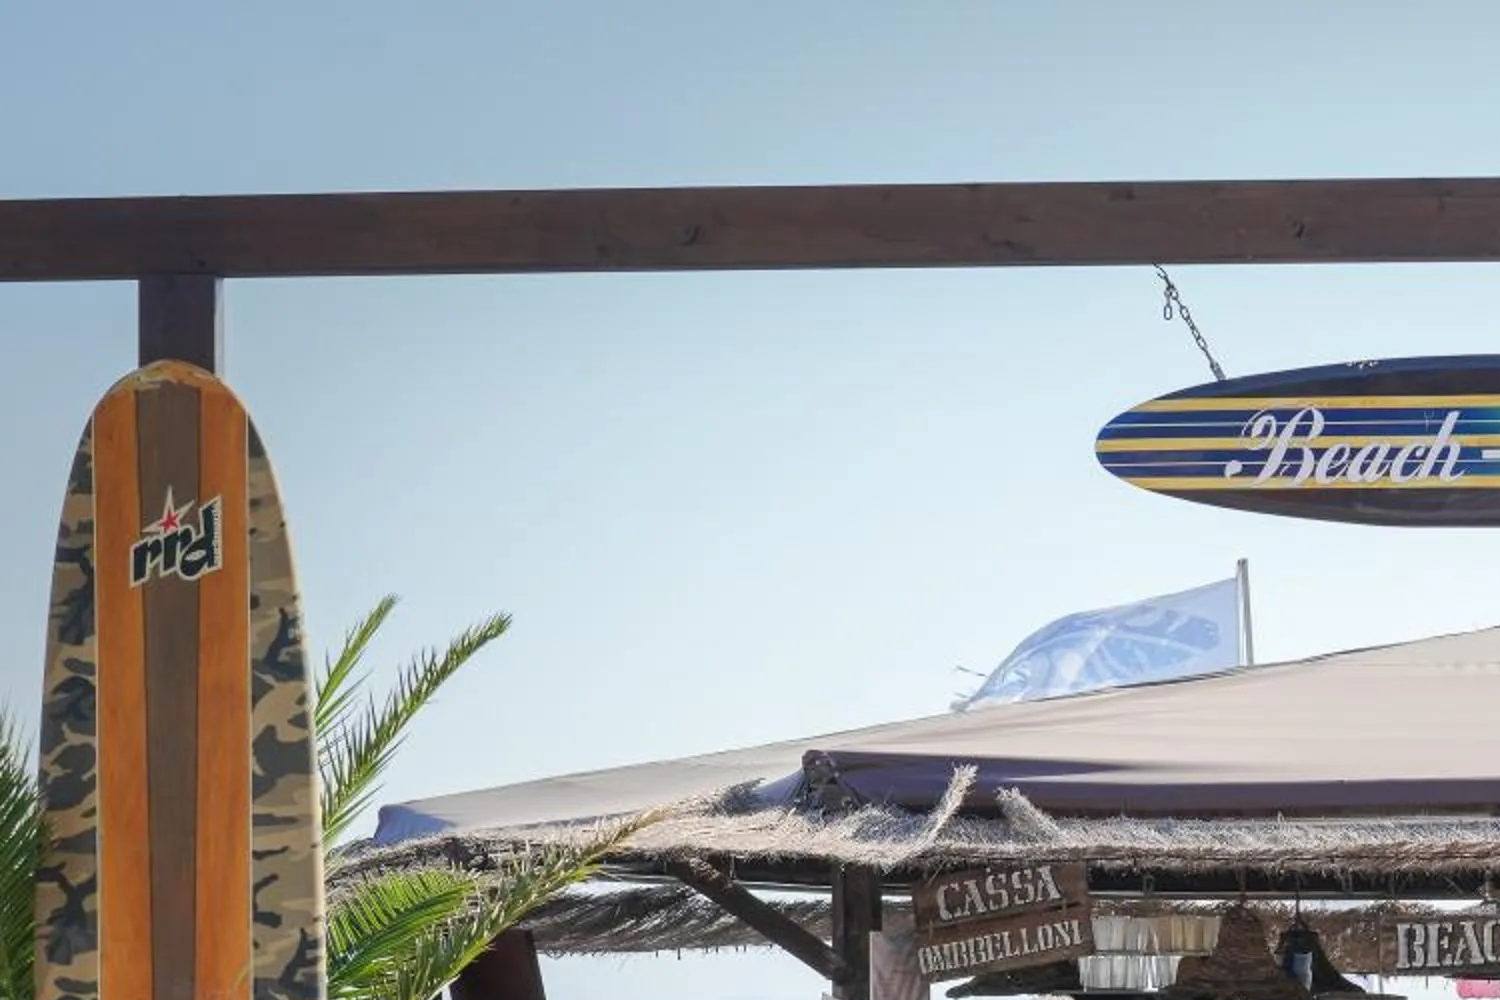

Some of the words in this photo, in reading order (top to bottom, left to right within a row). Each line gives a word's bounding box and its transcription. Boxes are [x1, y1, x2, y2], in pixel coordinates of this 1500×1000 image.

[1224, 402, 1465, 488] Beach
[936, 865, 1061, 921] CASSA
[918, 919, 1084, 975] OMBRELLONI
